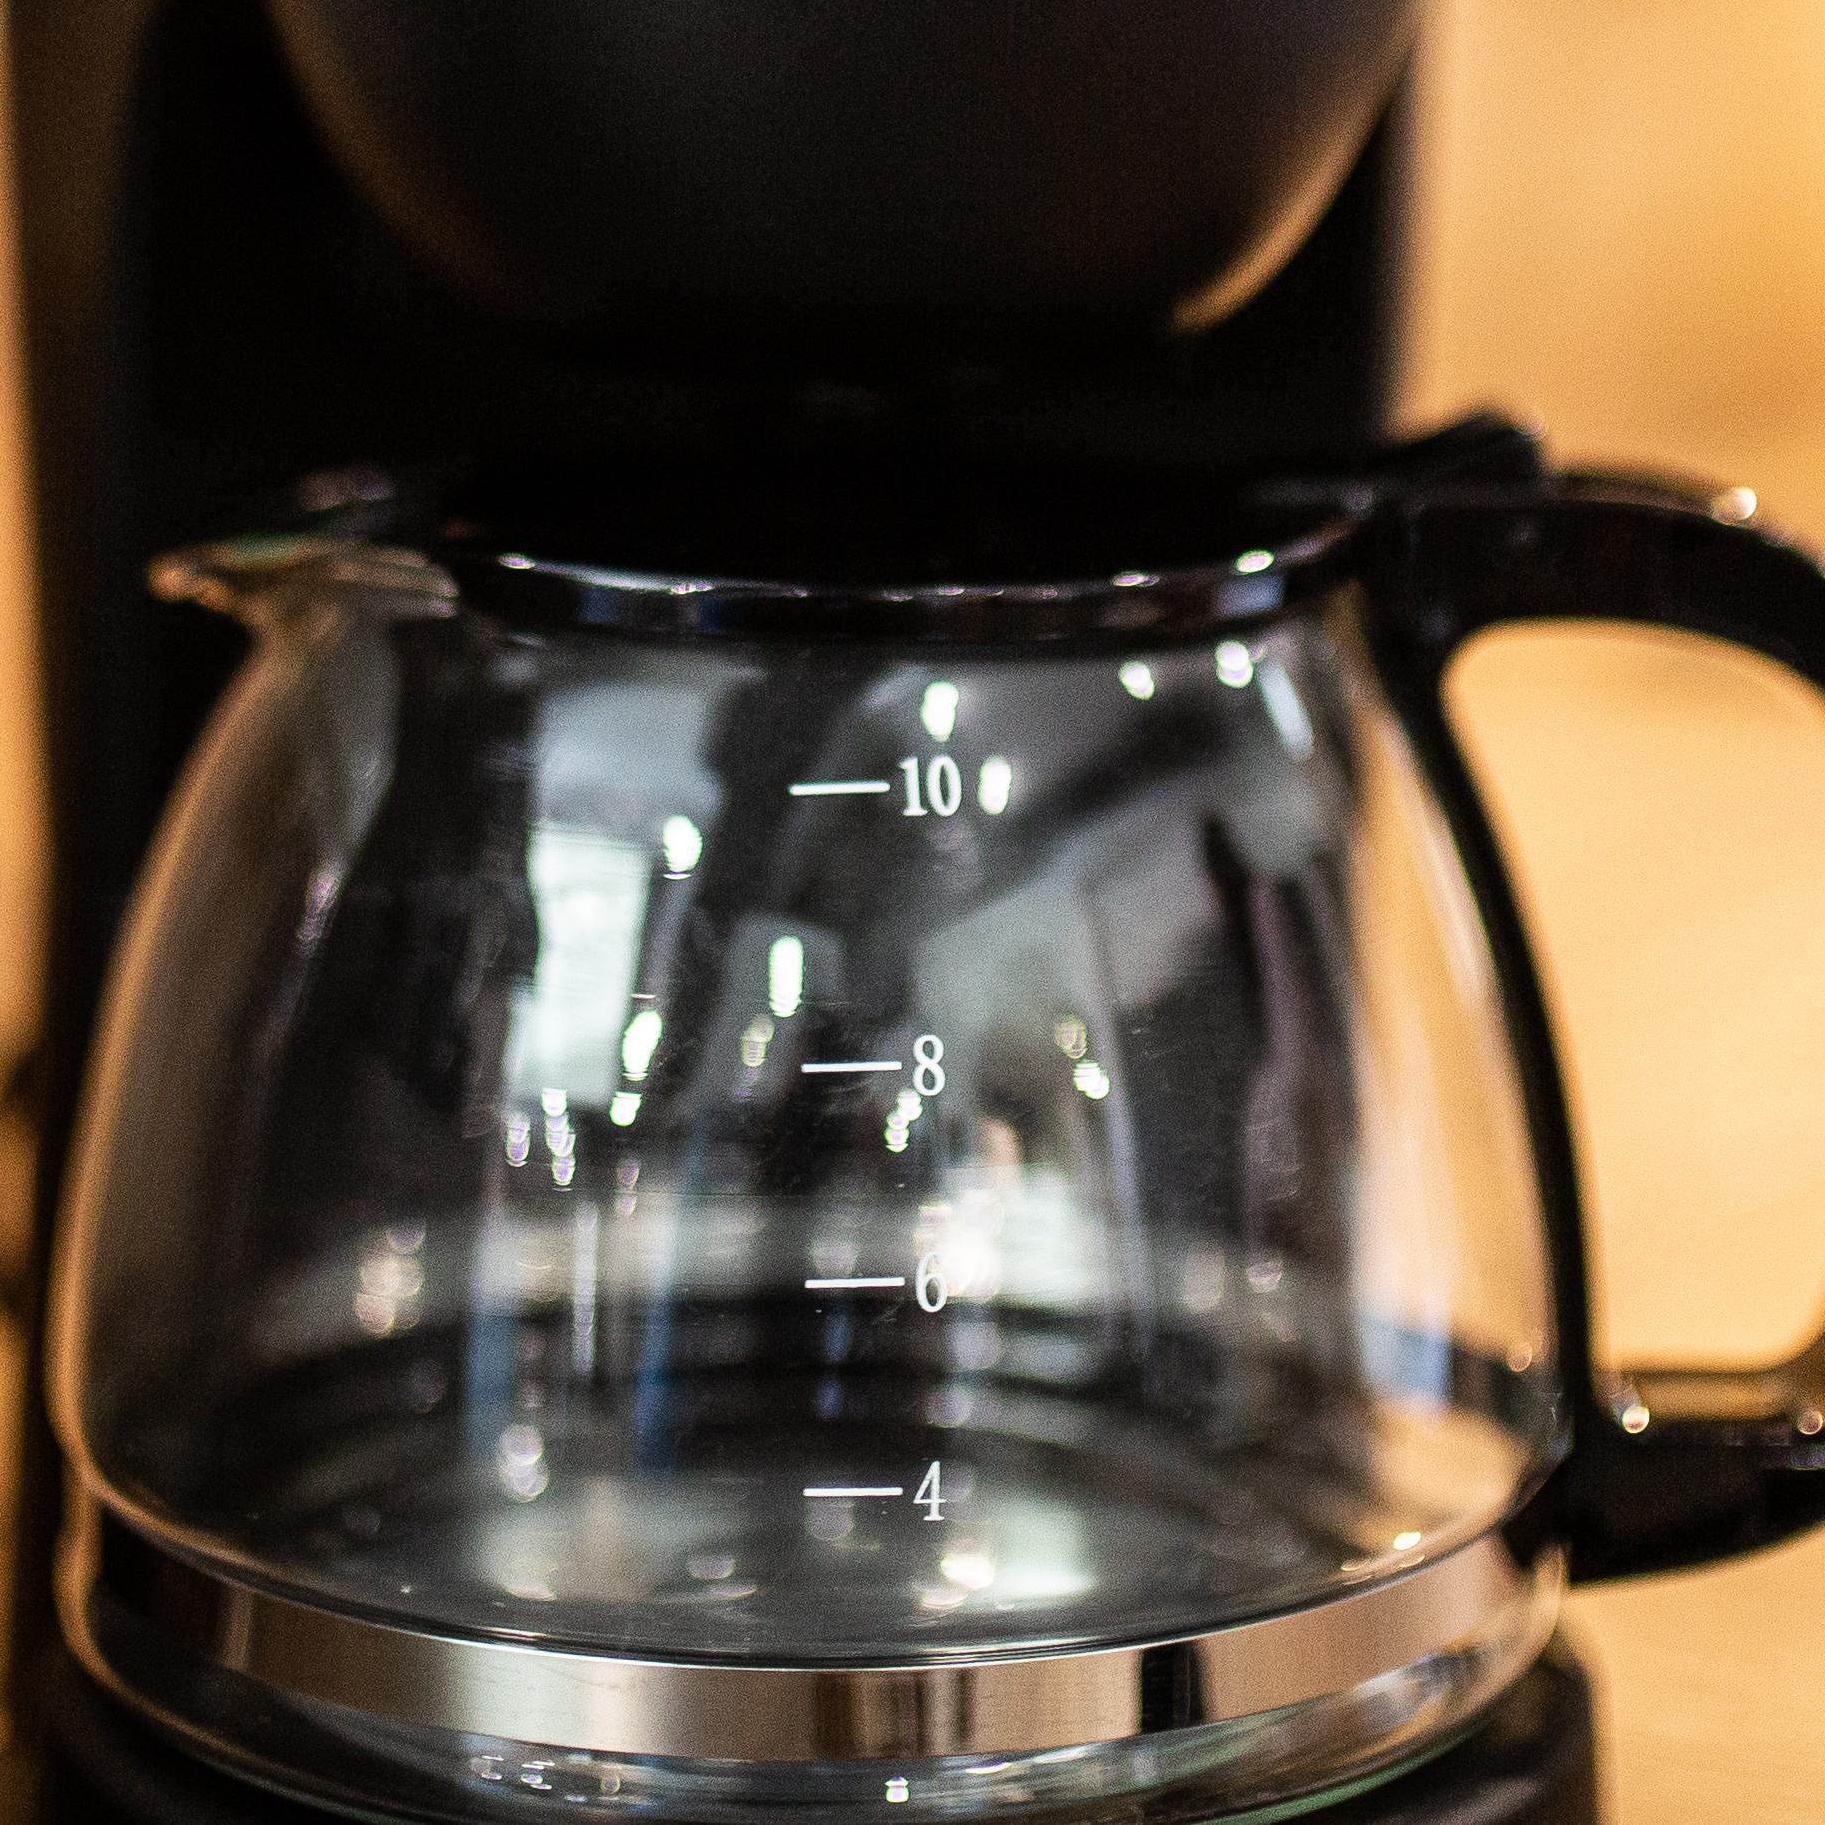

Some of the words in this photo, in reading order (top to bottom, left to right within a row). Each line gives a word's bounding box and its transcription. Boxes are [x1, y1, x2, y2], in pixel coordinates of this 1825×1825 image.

[902, 757, 962, 817] 10
[912, 1035, 946, 1097] 8
[915, 1251, 949, 1313] 6
[912, 1461, 947, 1521] 4
